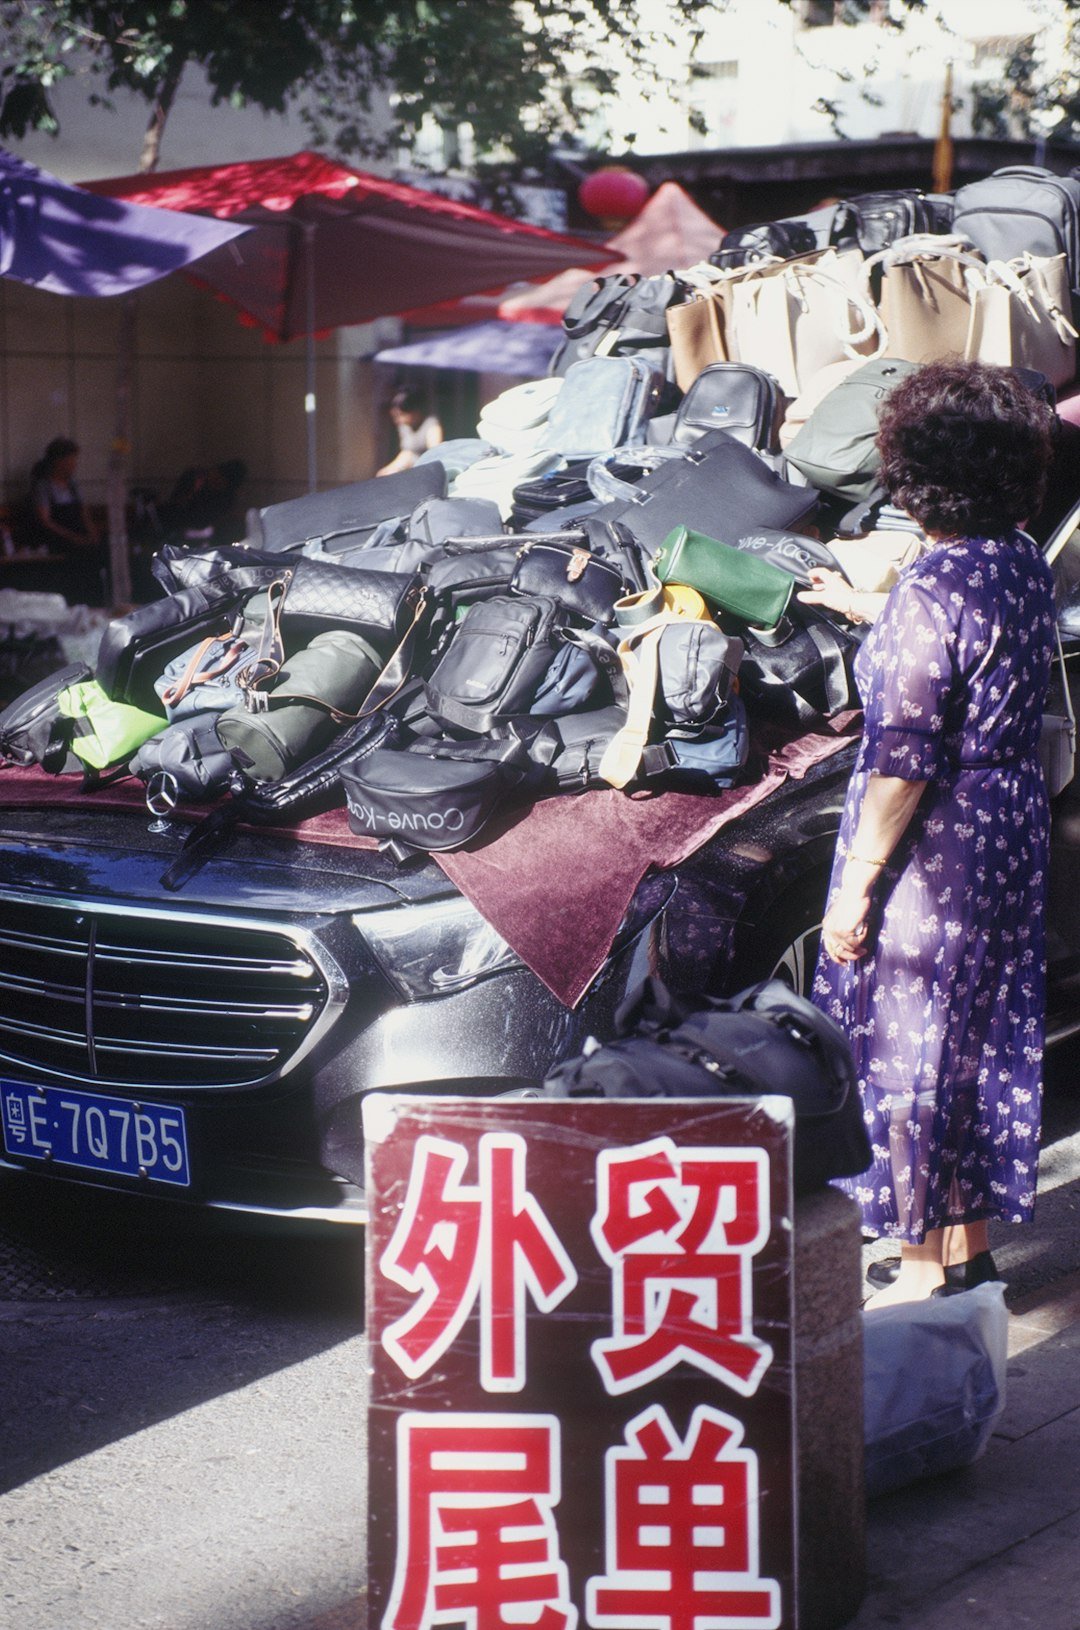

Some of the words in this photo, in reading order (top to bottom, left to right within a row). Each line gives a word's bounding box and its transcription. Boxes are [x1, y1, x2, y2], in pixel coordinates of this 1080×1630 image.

[344, 787, 464, 831] Couve-Ka
[380, 1132, 774, 1397] 外贸
[381, 1404, 781, 1630] 尾单
